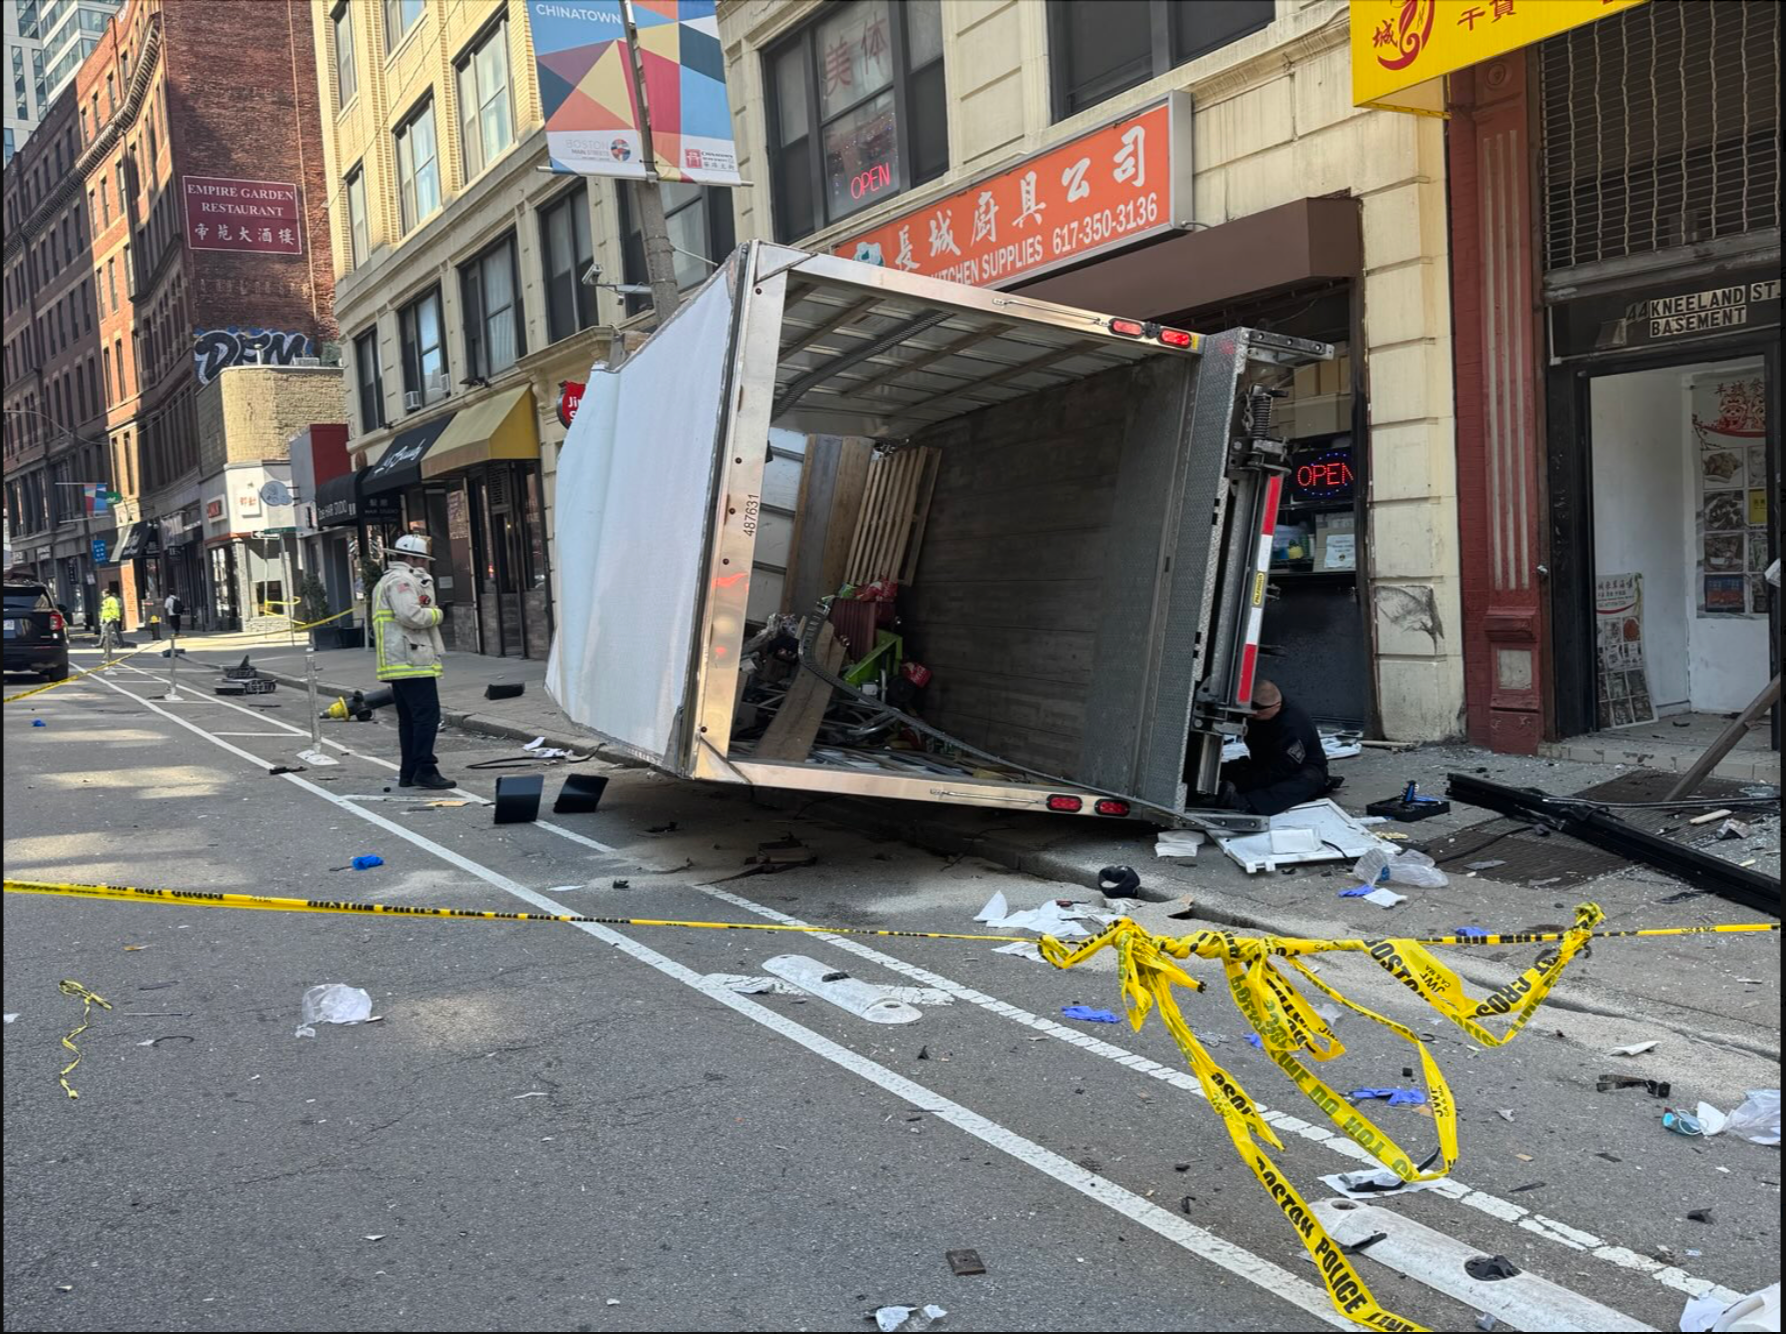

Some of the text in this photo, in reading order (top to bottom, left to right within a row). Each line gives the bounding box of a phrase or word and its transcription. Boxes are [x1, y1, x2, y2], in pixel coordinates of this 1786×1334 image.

[536, 4, 622, 24] CHINATOWN
[565, 139, 609, 150] BOSTON
[187, 184, 294, 200] EMPIRE GARDEN
[851, 162, 891, 199] OPEN
[201, 202, 284, 216] RESTAURANT
[981, 234, 1043, 279] SUPPLIES
[1052, 193, 1158, 255] 617-350-3136
[1651, 287, 1745, 316] KNEELAND
[1651, 306, 1746, 336] BASEMENT
[743, 494, 759, 537] 487631
[1420, 972, 1446, 994] JWT
[1314, 1236, 1369, 1315] POLICE
